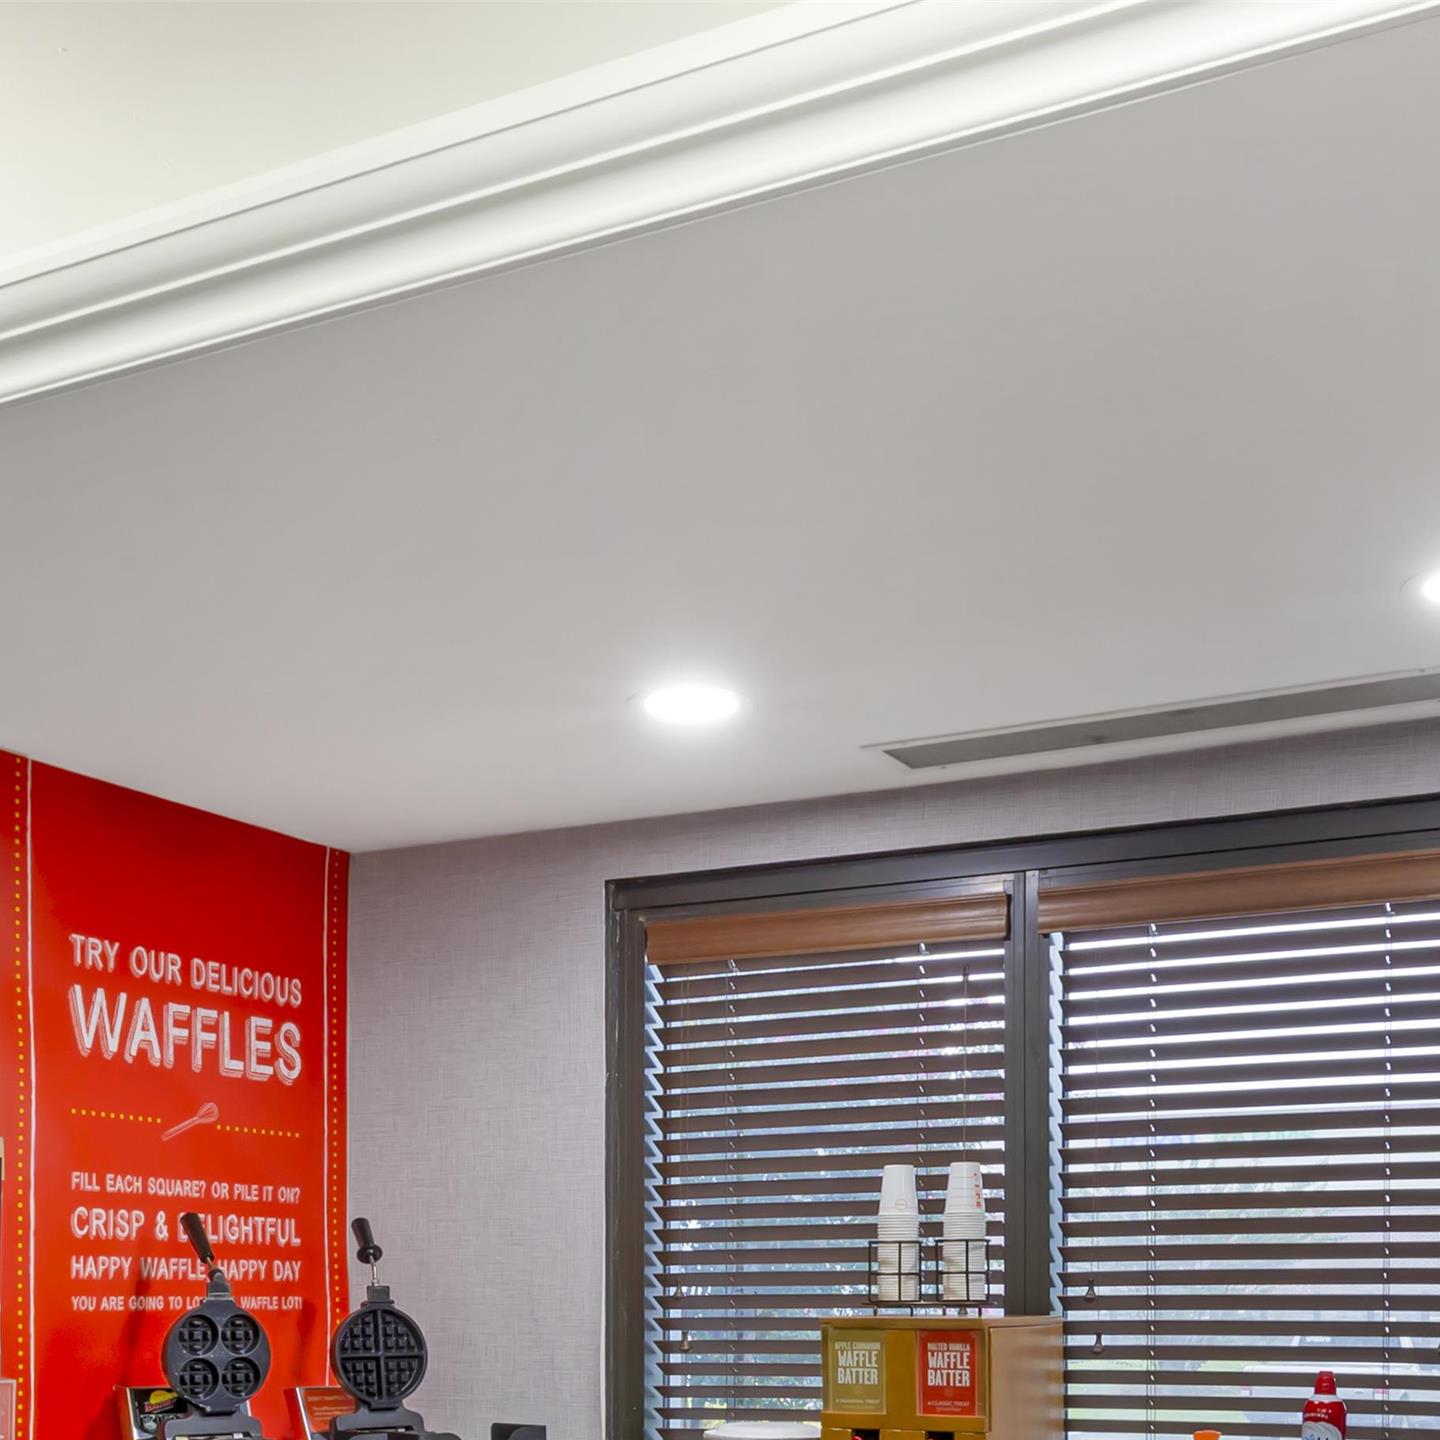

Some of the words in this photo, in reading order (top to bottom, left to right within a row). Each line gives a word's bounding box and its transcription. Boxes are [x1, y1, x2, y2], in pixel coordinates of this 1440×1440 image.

[69, 933, 120, 973] TRY
[130, 946, 182, 986] OUR
[190, 958, 303, 1008] DELICIOUS
[68, 984, 303, 1086] WAFFLES
[71, 1171, 100, 1192] FILL
[106, 1174, 142, 1194] EACH
[147, 1177, 207, 1198] SQUARE?
[211, 1181, 230, 1199] OR
[234, 1184, 259, 1201] PILE
[262, 1185, 274, 1202] IT
[278, 1187, 301, 1204] ON?
[71, 1206, 145, 1240] CRISP
[154, 1210, 169, 1242] &
[71, 1256, 132, 1280] HAPPY
[217, 1259, 267, 1281] HAPPY
[273, 1260, 301, 1281] DAY
[71, 1296, 97, 1312] YOU
[100, 1296, 124, 1311] ARE
[129, 1296, 164, 1311] GOING
[168, 1296, 183, 1311] TO
[241, 1296, 279, 1310] WAFFLE
[282, 1296, 303, 1310] LOT!
[837, 1350, 878, 1367] WAFFLE
[927, 1351, 970, 1369] WAFFLE
[837, 1368, 878, 1384] BATTER
[927, 1369, 970, 1387] BATTER
